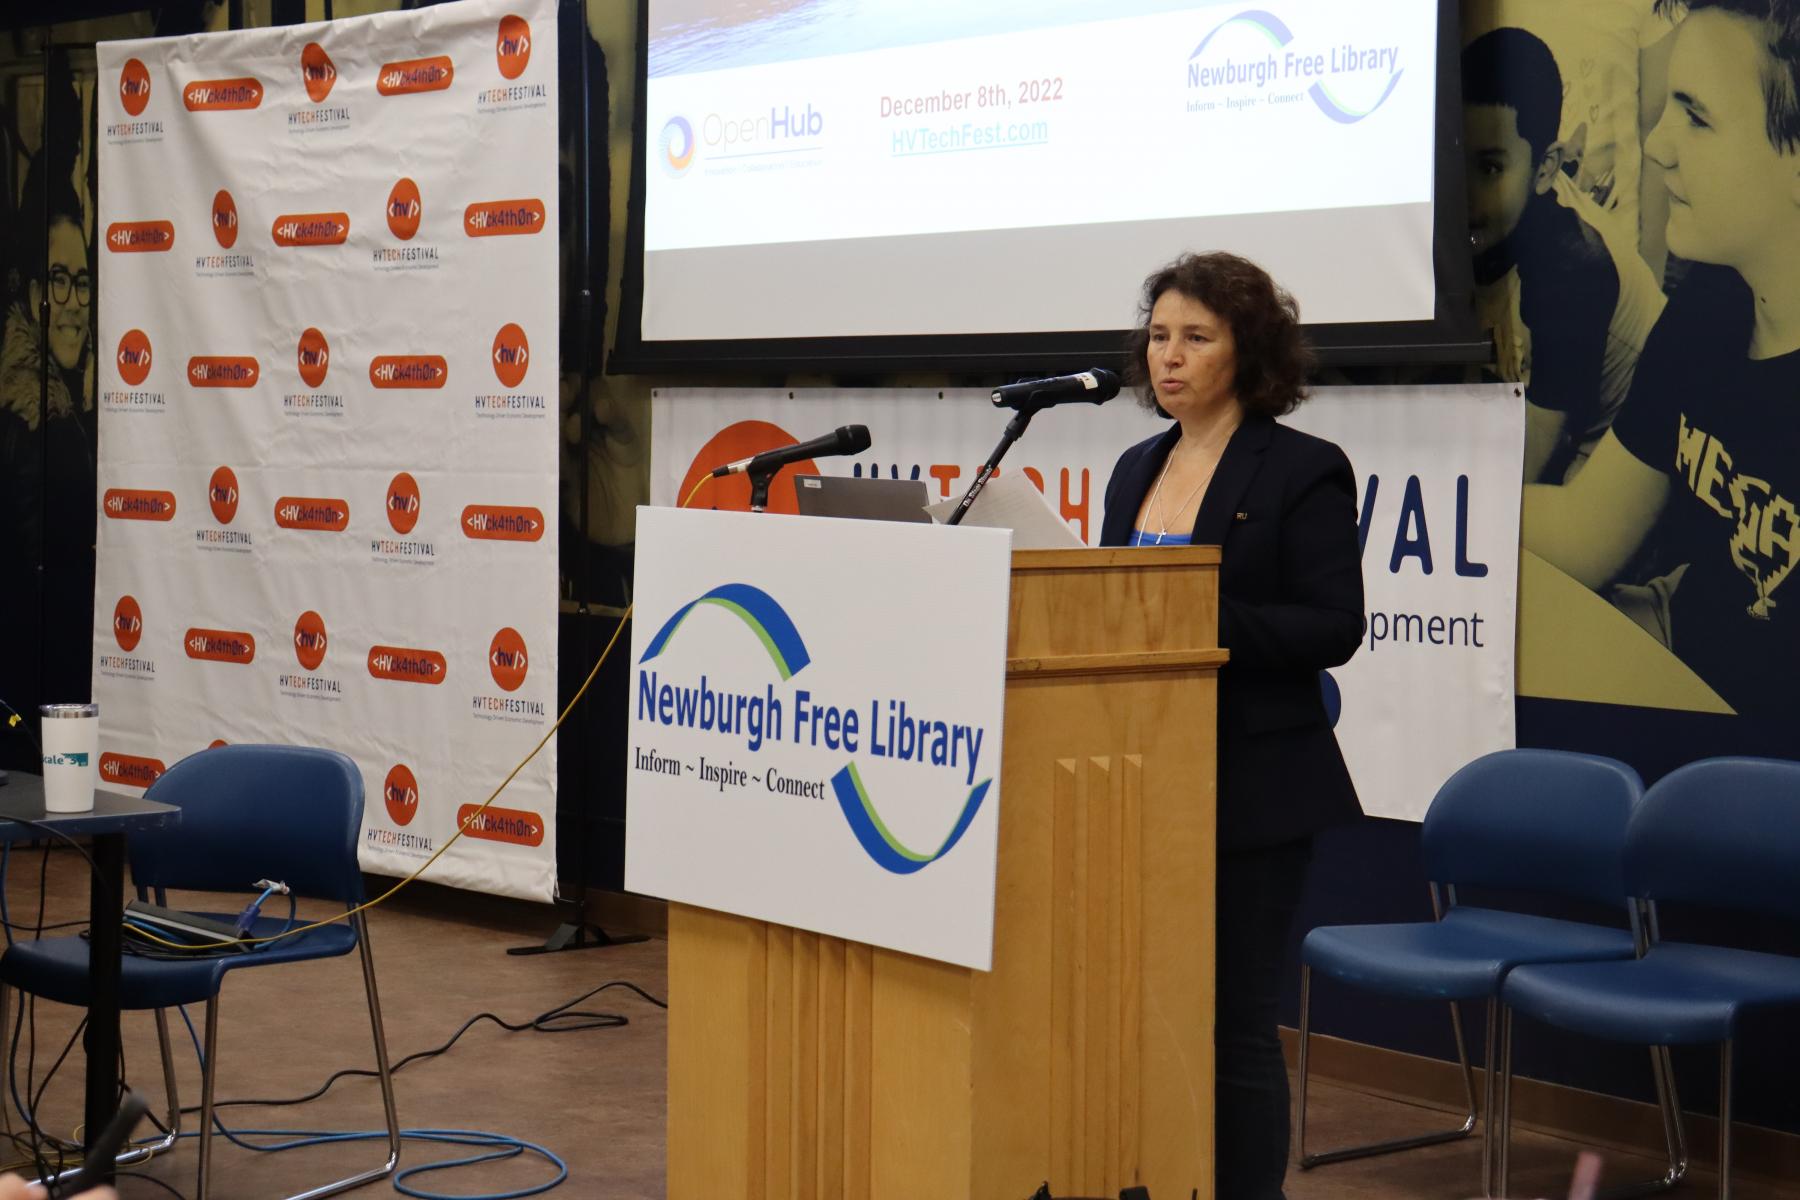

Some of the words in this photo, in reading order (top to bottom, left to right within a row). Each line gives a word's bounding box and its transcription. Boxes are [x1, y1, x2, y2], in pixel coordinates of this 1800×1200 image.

[1187, 53, 1278, 88] Newburgh
[1284, 52, 1324, 78] Free
[1331, 44, 1399, 74] Library
[477, 84, 546, 104] HVTECHFESTIVAL
[880, 89, 972, 118] December
[977, 83, 1012, 110] 8th,
[1018, 77, 1064, 104] 2022
[1186, 100, 1215, 113] Inform
[1226, 96, 1256, 111] Inspire
[1268, 91, 1304, 105] Connect
[288, 107, 350, 125] HVTECHFESTIVAL
[107, 122, 164, 136] HVTECHFESTIVAL
[703, 103, 823, 153] OpenHub
[891, 120, 1048, 153] HVTechFest.com
[196, 255, 254, 269] HVTECHFESTIVAL
[373, 247, 439, 262] HVTECHFESTIVAL
[104, 392, 165, 405] HVTECHFESTIVAL
[284, 394, 344, 408] HVTECHFESTIVAL
[475, 395, 545, 409] HVTECHFESTIVAL
[196, 529, 252, 545] HVTECHFESTIVAL
[371, 540, 435, 556] HVTECHFESTIVAL
[1364, 610, 1484, 651] pment
[100, 655, 155, 673] HVTECHFESTIVAL
[280, 674, 341, 693] HVTECHFESTIVAL
[473, 696, 544, 716] HVTECHFESTIVAL
[638, 670, 782, 752] Newburgh
[794, 689, 859, 753] Free
[870, 699, 984, 786] Library
[635, 747, 681, 777] Inform
[699, 756, 747, 792] Inspire
[766, 768, 825, 801] Connect
[368, 828, 433, 851] HVTECHFESTIVAL
